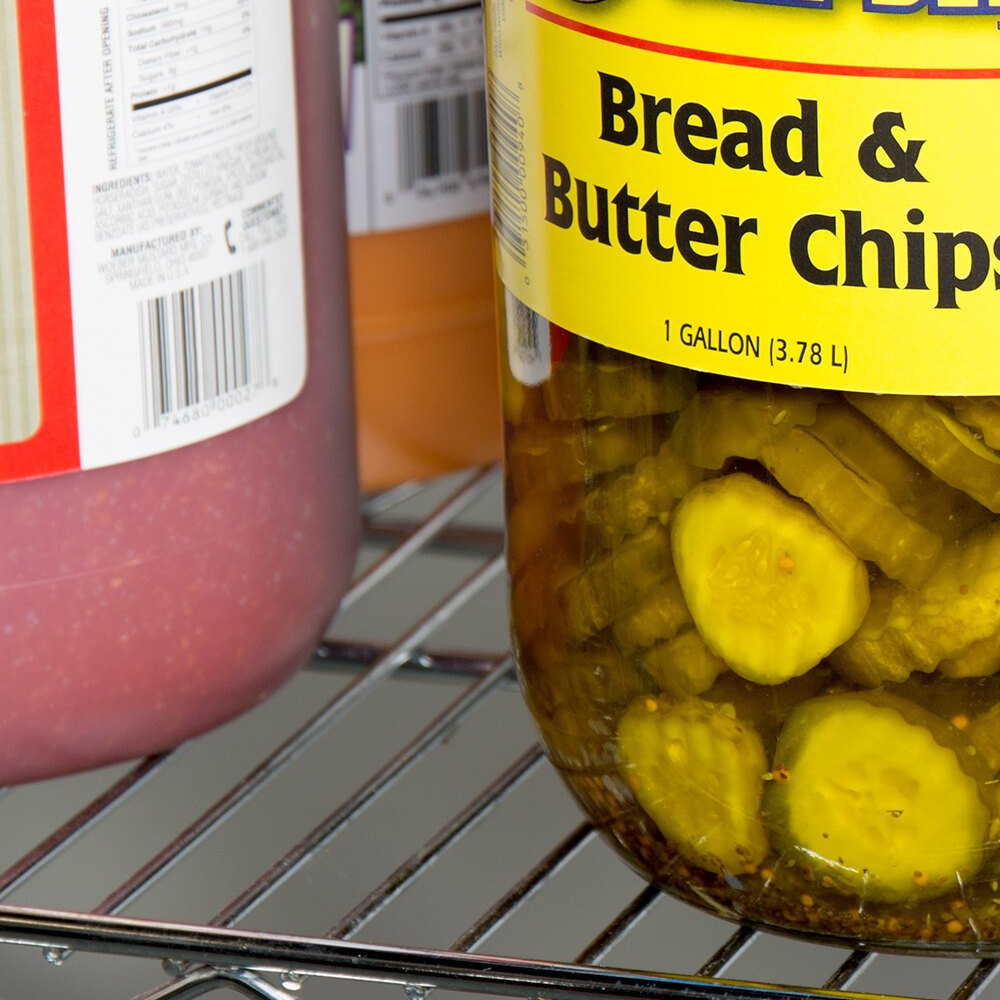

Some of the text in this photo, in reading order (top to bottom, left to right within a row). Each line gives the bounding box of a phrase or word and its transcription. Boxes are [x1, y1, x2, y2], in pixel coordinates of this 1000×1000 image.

[100, 7, 118, 171] REFRIGERATE AFTER OPENING
[597, 71, 929, 183] Bread &
[111, 229, 186, 258] MANUFACTURED
[542, 153, 758, 276] Butter
[665, 320, 848, 373] 1 GALLON (3.78 L)
